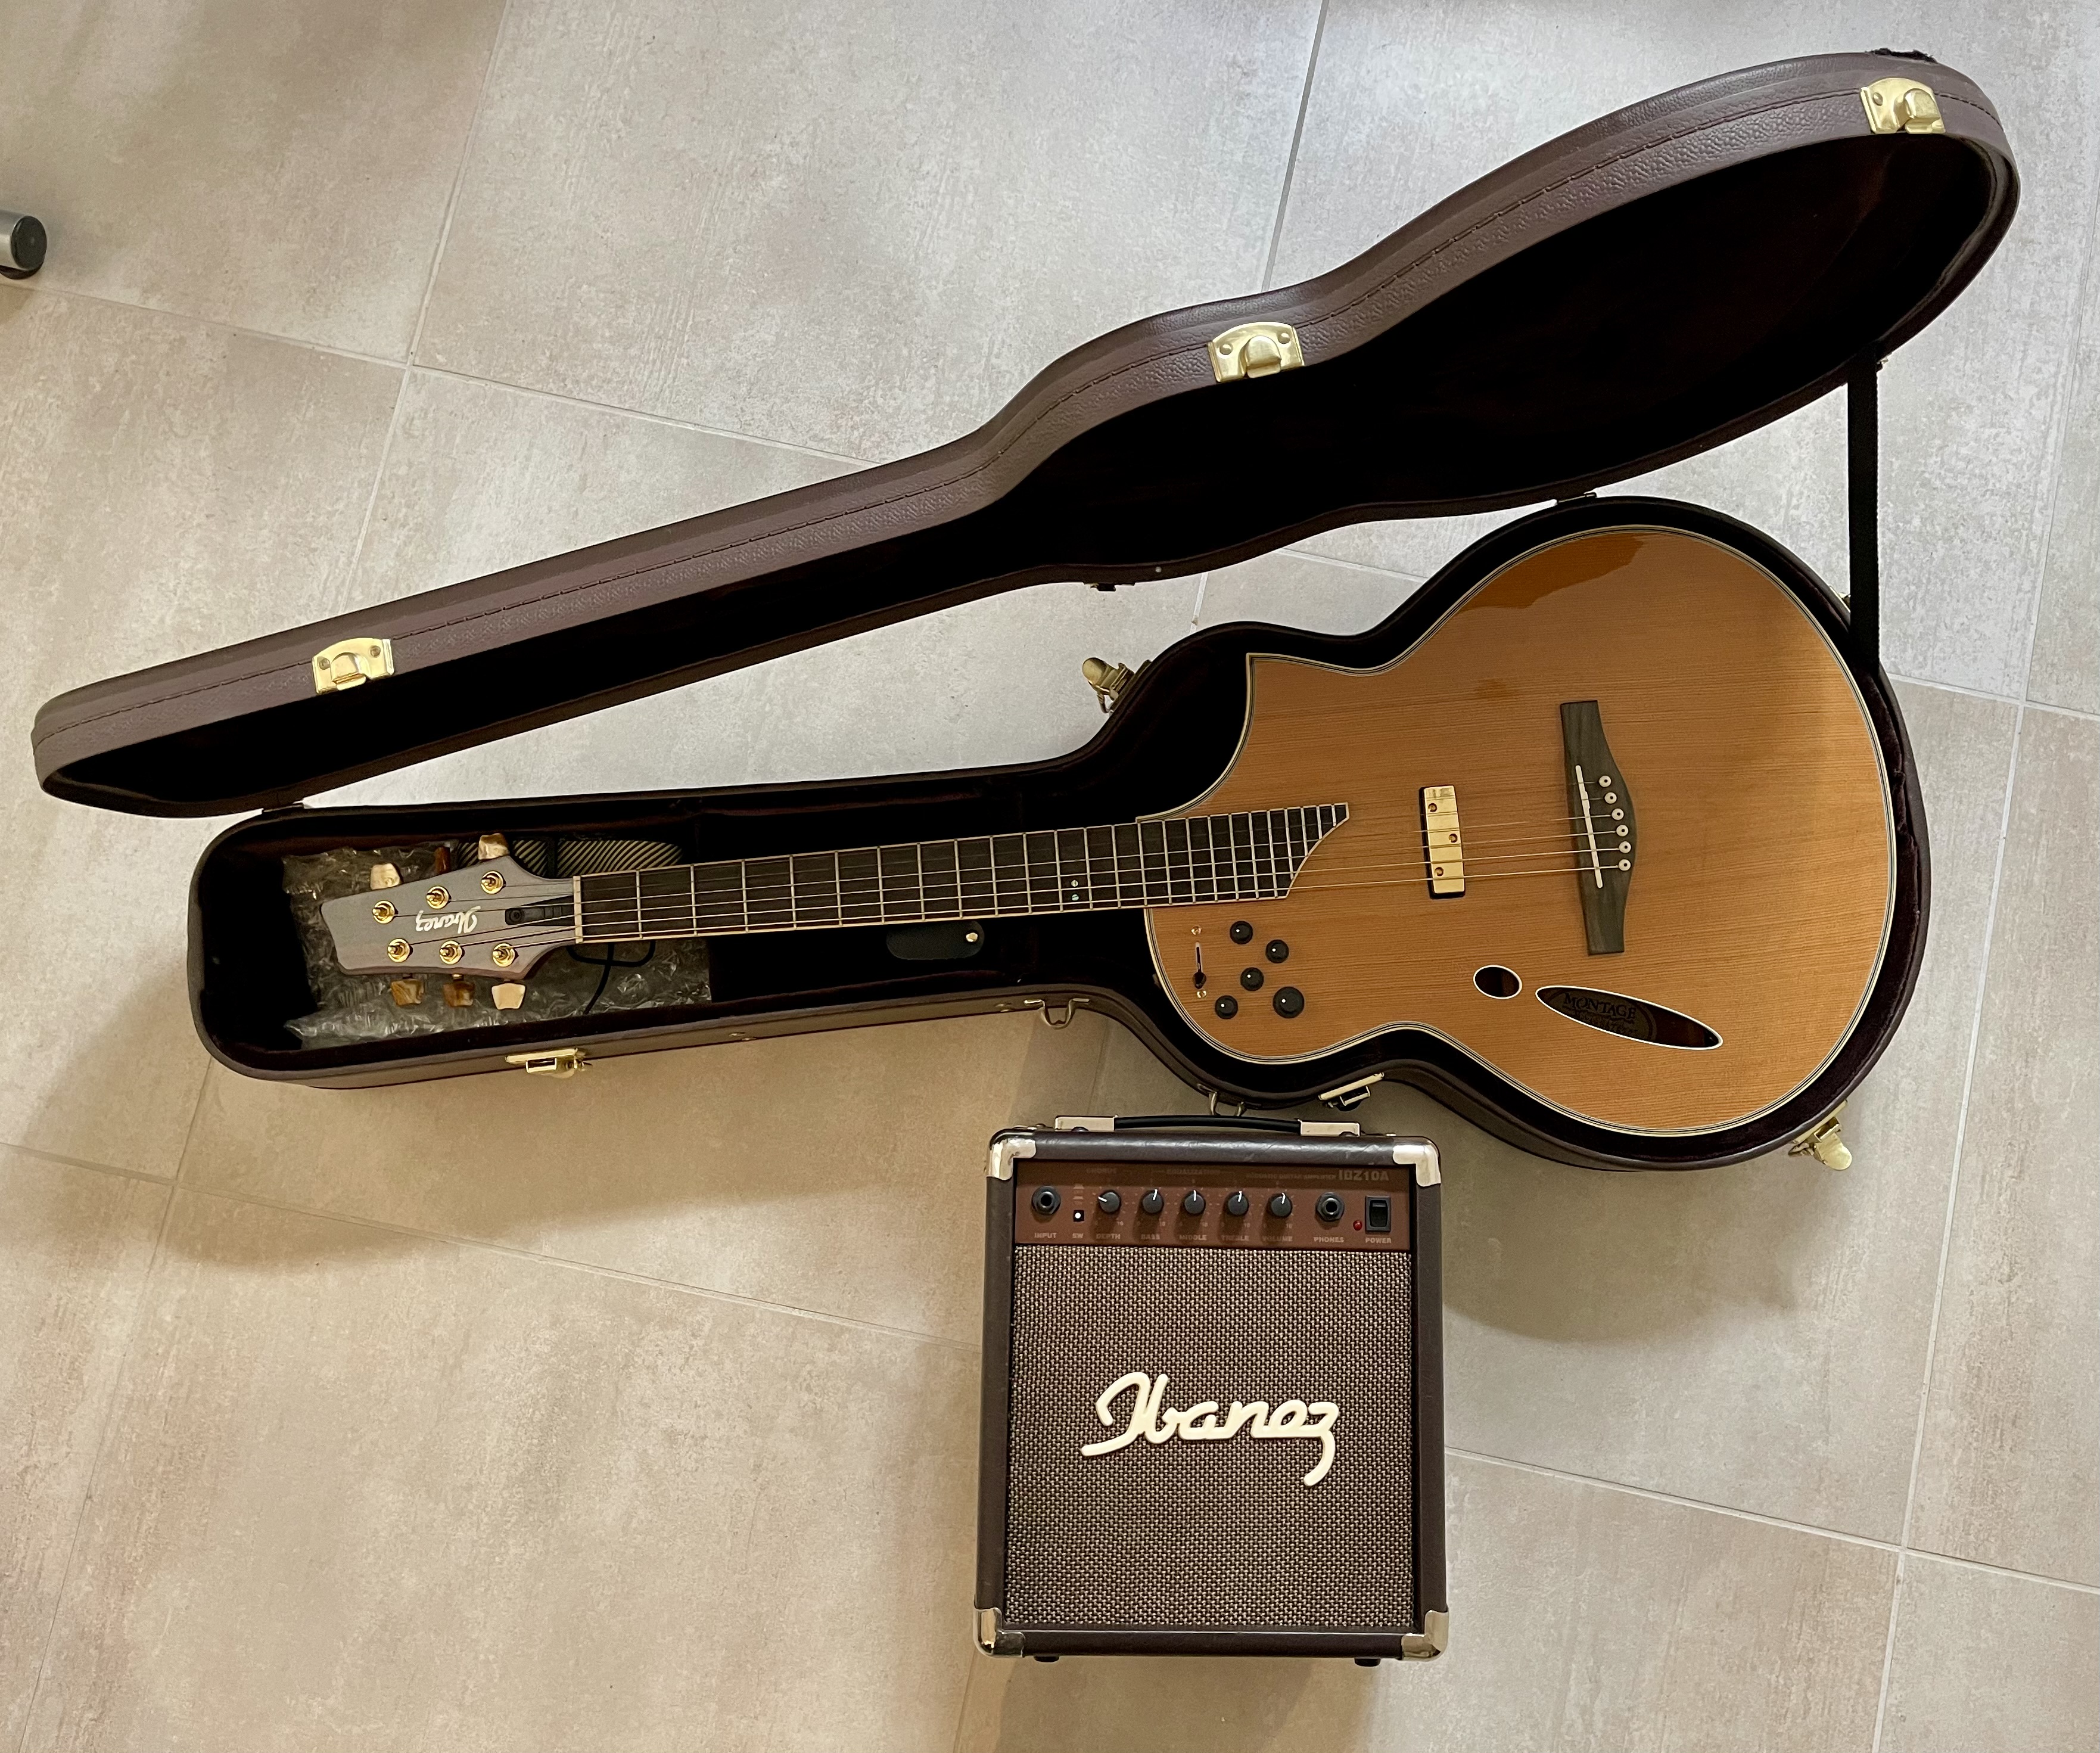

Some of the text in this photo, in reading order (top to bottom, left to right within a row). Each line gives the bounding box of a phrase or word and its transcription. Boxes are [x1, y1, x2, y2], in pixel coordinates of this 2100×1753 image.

[416, 906, 481, 934] Ibanez
[1563, 992, 1637, 1019] MONTAGE
[1081, 1371, 1340, 1487] Ibanez
